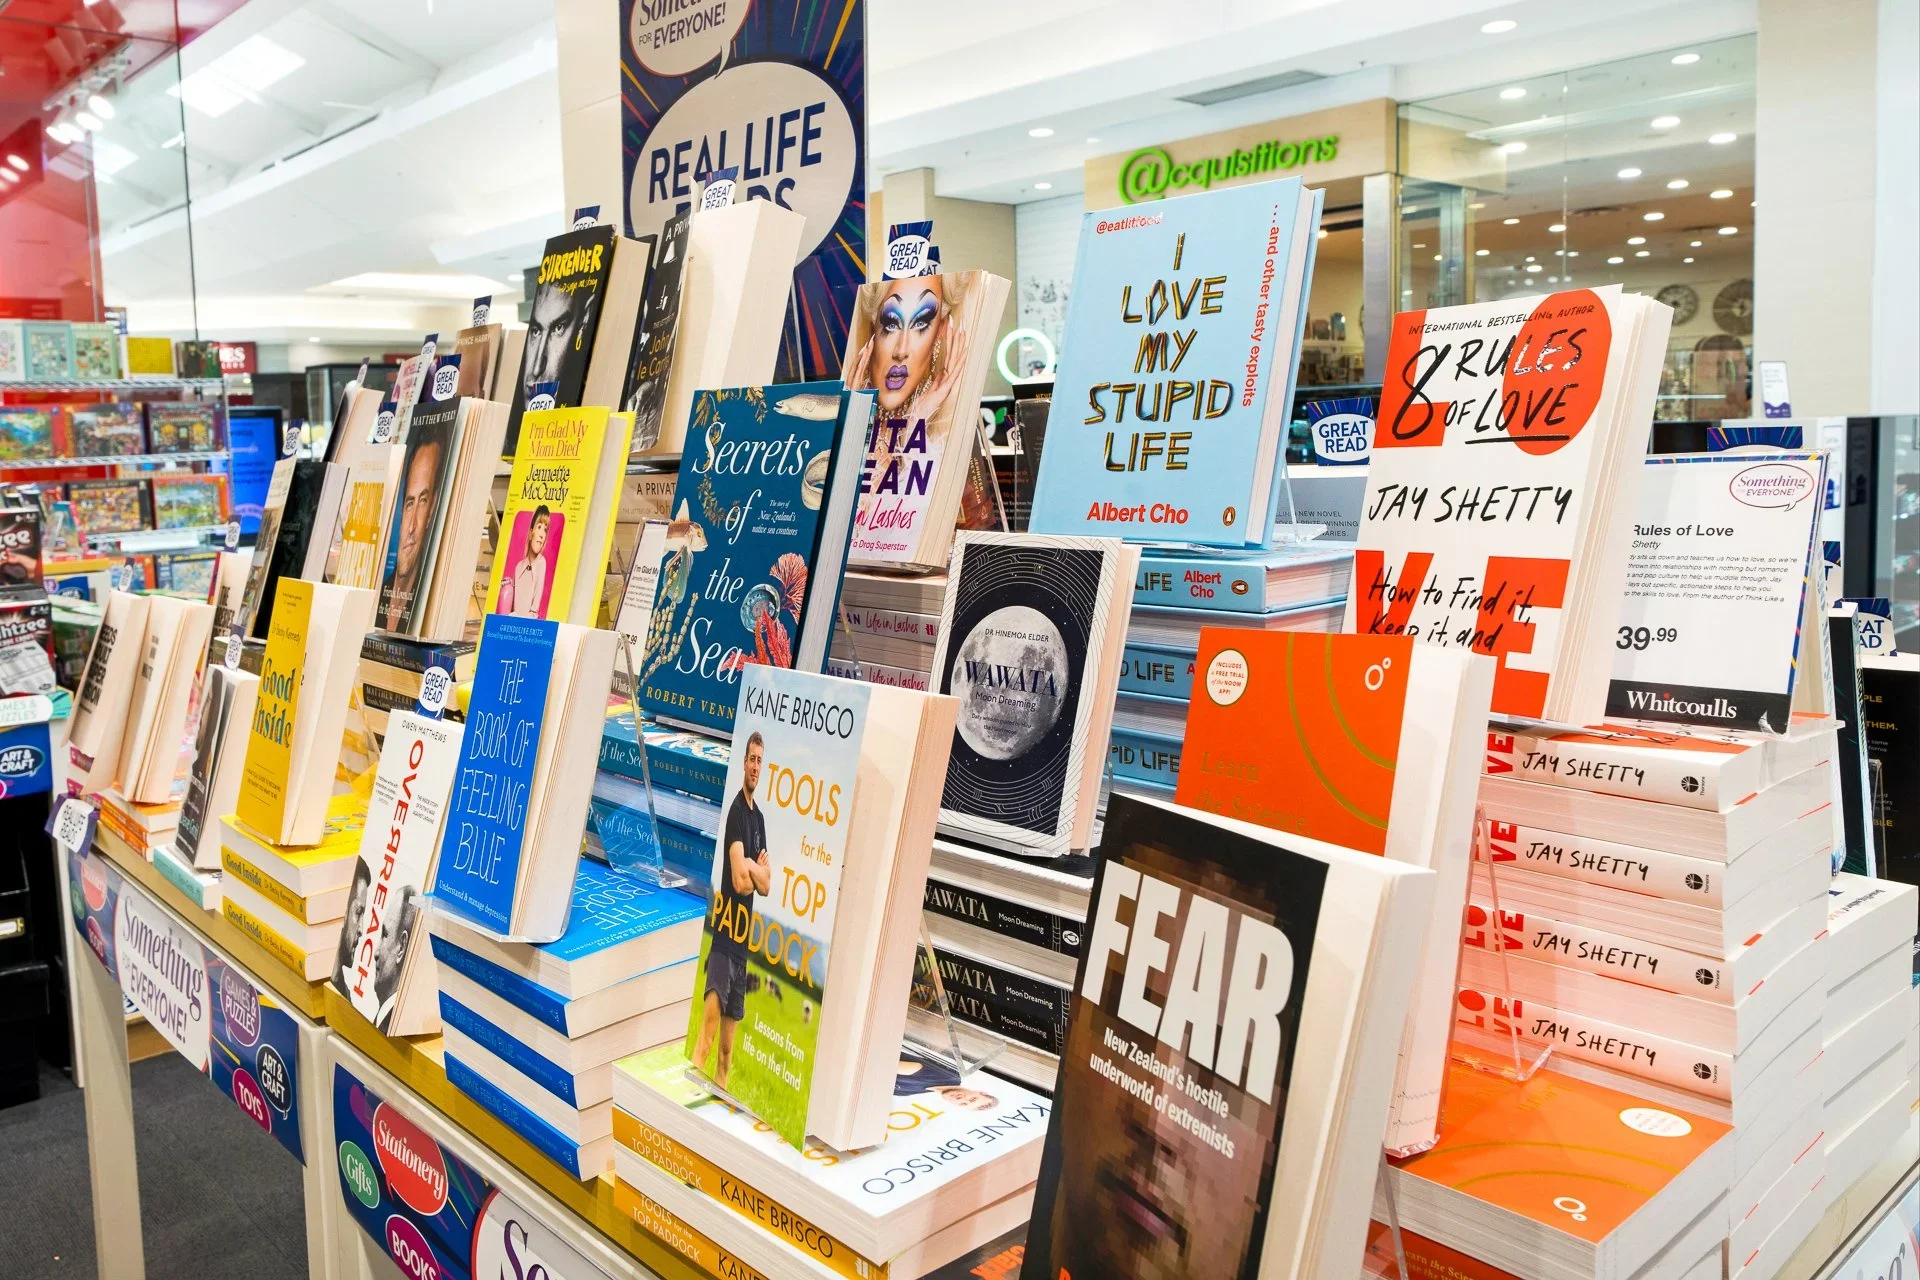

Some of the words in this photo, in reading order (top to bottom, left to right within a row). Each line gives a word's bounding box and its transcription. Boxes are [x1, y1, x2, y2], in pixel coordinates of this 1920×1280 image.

[639, 33, 652, 45] FOR
[654, 2, 726, 49] EVERYONE!
[649, 130, 740, 203] REAL
[743, 102, 826, 180] LIFE
[1118, 135, 1338, 206] @cquisitions
[706, 184, 732, 200] GREAT
[538, 244, 604, 285] SURRENDER
[889, 241, 925, 257] GREAT
[889, 256, 919, 270] READ
[1173, 232, 1185, 270] I
[1260, 257, 1276, 300] other
[1121, 276, 1227, 326] LOVE
[1408, 318, 1483, 335] INTERNATIONAL
[1487, 310, 1554, 328] BESTSELLING
[1556, 304, 1595, 318] AUTHOR
[1251, 303, 1270, 343] tasty
[1134, 329, 1198, 373] MY
[436, 383, 453, 394] READ
[437, 371, 456, 383] GREAT
[1242, 346, 1261, 407] exploits
[1392, 344, 1452, 440] 8
[1454, 328, 1588, 382] RULES
[412, 414, 442, 426] MATTHEW
[1084, 379, 1233, 424] STUPID
[1443, 399, 1476, 427] OF
[1473, 383, 1580, 434] LOVE
[528, 423, 545, 439] I'm
[546, 421, 568, 438] Glad
[571, 420, 589, 443] My
[528, 441, 556, 457] Mom
[557, 439, 581, 457] Died
[691, 422, 810, 475] Secrets
[1319, 421, 1368, 438] GREAT
[1325, 437, 1367, 453] READ
[1104, 431, 1192, 472] LIFE
[526, 464, 570, 483] Jennette
[637, 483, 644, 494] A
[646, 483, 676, 495] PRIVAT
[1738, 476, 1808, 488] Something
[1746, 488, 1795, 496] EVERYONE!
[521, 482, 569, 508] McCurdy
[869, 497, 917, 531] Lashes
[1087, 502, 1146, 523] Albert
[1149, 503, 1189, 524] Cho
[1368, 483, 1428, 522] JAY
[1434, 485, 1573, 524] SHETTY
[725, 489, 762, 545] of
[1676, 524, 1692, 536] of
[1696, 524, 1734, 537] Love
[859, 540, 874, 551] Drag
[875, 541, 907, 552] Superstar
[1632, 540, 1661, 550] Shetty
[704, 558, 744, 603] the
[1184, 570, 1221, 585] Albert
[1662, 563, 1702, 571] relationships
[1719, 565, 1743, 573] nothing
[1190, 585, 1215, 599] Cho
[1368, 566, 1415, 603] How
[1423, 574, 1443, 605] to
[1449, 576, 1507, 615] Find
[1507, 585, 1536, 626] it,
[674, 617, 743, 685] Sea
[985, 628, 994, 636] DR
[995, 630, 1027, 640] HINEMOA
[1029, 633, 1049, 642] ELDER
[1368, 613, 1420, 635] Keep
[1427, 615, 1449, 648] it,
[1456, 624, 1504, 651] and
[262, 658, 296, 703] Good
[498, 658, 528, 706] THE
[964, 661, 1057, 697] WAWATA
[252, 696, 292, 748] Inside
[744, 686, 789, 723] KANE
[791, 696, 854, 739] BRISCO
[976, 692, 997, 703] Moon
[998, 695, 1036, 712] Dreaming
[1626, 690, 1737, 719] Whitcoulls
[402, 720, 417, 731] OWEN
[419, 726, 447, 742] MATTHEWS
[469, 710, 512, 764] BOOK
[511, 719, 535, 768] OF
[0, 758, 34, 773] CRAFT
[1, 750, 21, 763] ART
[21, 750, 31, 760] &
[1201, 752, 1260, 782] Learn
[1522, 752, 1559, 772] JAY
[1565, 758, 1645, 787] SHETTY
[456, 767, 526, 831] FEELING
[767, 762, 841, 827] TOOLS
[454, 821, 506, 886] BLUE
[801, 835, 815, 856] for
[816, 842, 832, 866] the
[1526, 842, 1563, 864] JAY
[1569, 850, 1649, 882] SHETTY
[439, 879, 464, 904] Understand
[468, 894, 485, 913] manage
[485, 902, 508, 924] depression
[781, 866, 827, 923] TOP
[122, 895, 204, 1022] Something
[711, 890, 818, 989] PADDOCK
[224, 975, 250, 1010] GAMES
[250, 998, 257, 1018] &
[1082, 858, 1294, 1106] FEAR
[130, 964, 188, 1044] EVERYONE!
[225, 994, 256, 1037] PUZZLES
[754, 1011, 786, 1046] Lessons
[785, 1031, 805, 1062] from
[262, 1051, 277, 1076] ART
[276, 1064, 284, 1081] &
[742, 1032, 758, 1056] life
[756, 1045, 768, 1064] on
[767, 1050, 782, 1074] the
[782, 1063, 802, 1092] land
[1103, 1026, 1129, 1052] New
[1129, 1042, 1185, 1092] Zealand's
[1185, 1073, 1229, 1120] hostile
[238, 1082, 264, 1122] TOYS
[261, 1068, 286, 1104] CRAFT
[1089, 1054, 1153, 1105] underworld
[1154, 1092, 1168, 1115] of
[1168, 1101, 1235, 1160] extremists
[346, 1153, 372, 1196] Gifts
[376, 1119, 444, 1200] Stationery
[720, 1177, 765, 1221] KANE
[770, 1205, 834, 1258] BRISCO
[391, 1230, 436, 1280] BOOKS
